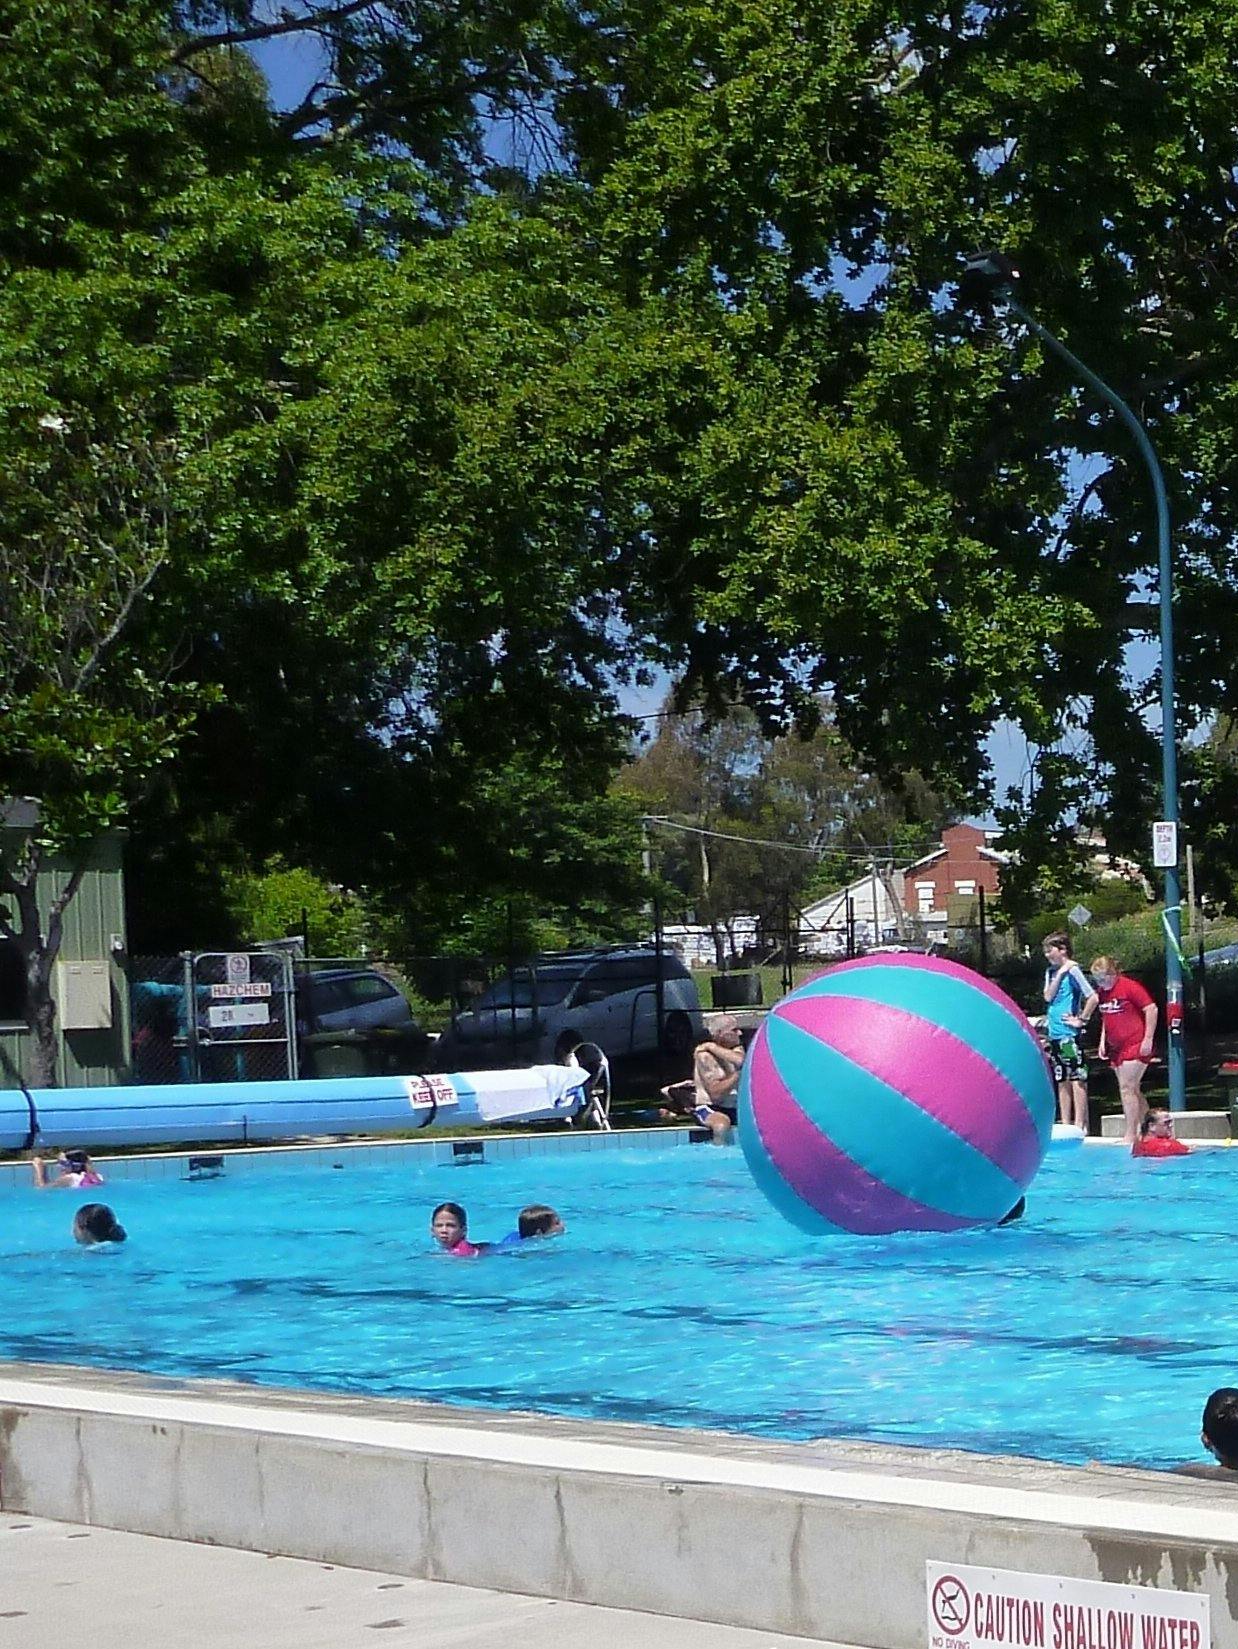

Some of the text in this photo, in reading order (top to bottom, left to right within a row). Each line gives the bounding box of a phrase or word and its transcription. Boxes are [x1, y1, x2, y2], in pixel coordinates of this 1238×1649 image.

[213, 984, 269, 997] HAZCHEM
[436, 1088, 453, 1101] OFF
[974, 1592, 1200, 1649] CAUTION SHALLOW WATER
[932, 1636, 943, 1648] NO
